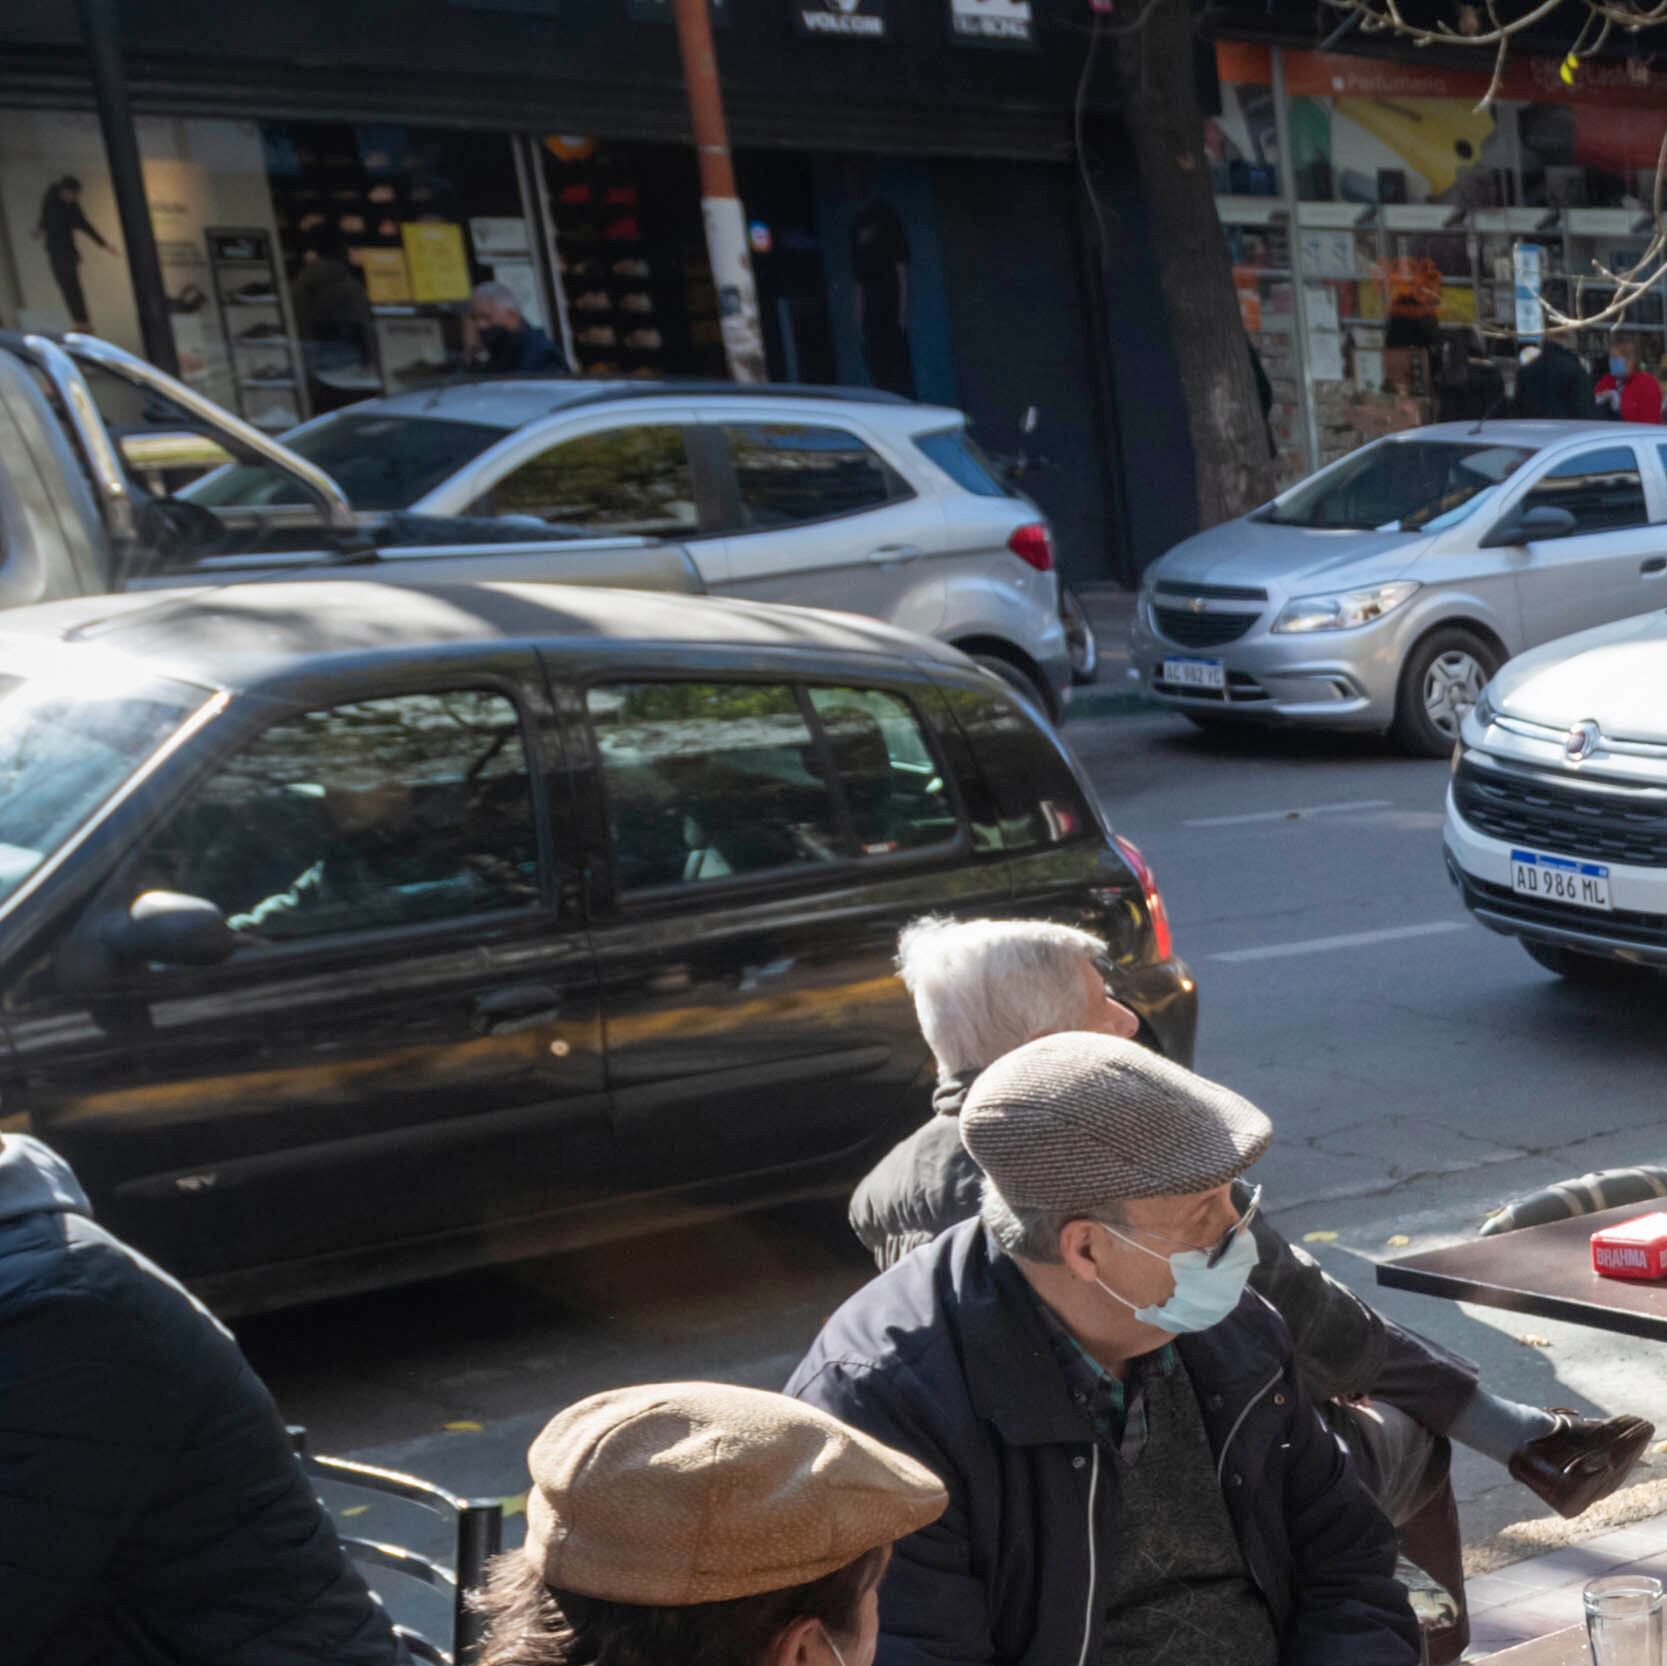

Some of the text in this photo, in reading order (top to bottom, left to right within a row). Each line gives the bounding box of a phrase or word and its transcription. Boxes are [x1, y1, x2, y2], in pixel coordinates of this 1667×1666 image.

[802, 11, 882, 36] VOLCOM
[1517, 865, 1537, 891] AD
[1543, 870, 1576, 898] 986
[1582, 878, 1605, 904] ML
[1596, 1247, 1648, 1270] BRAHMA
